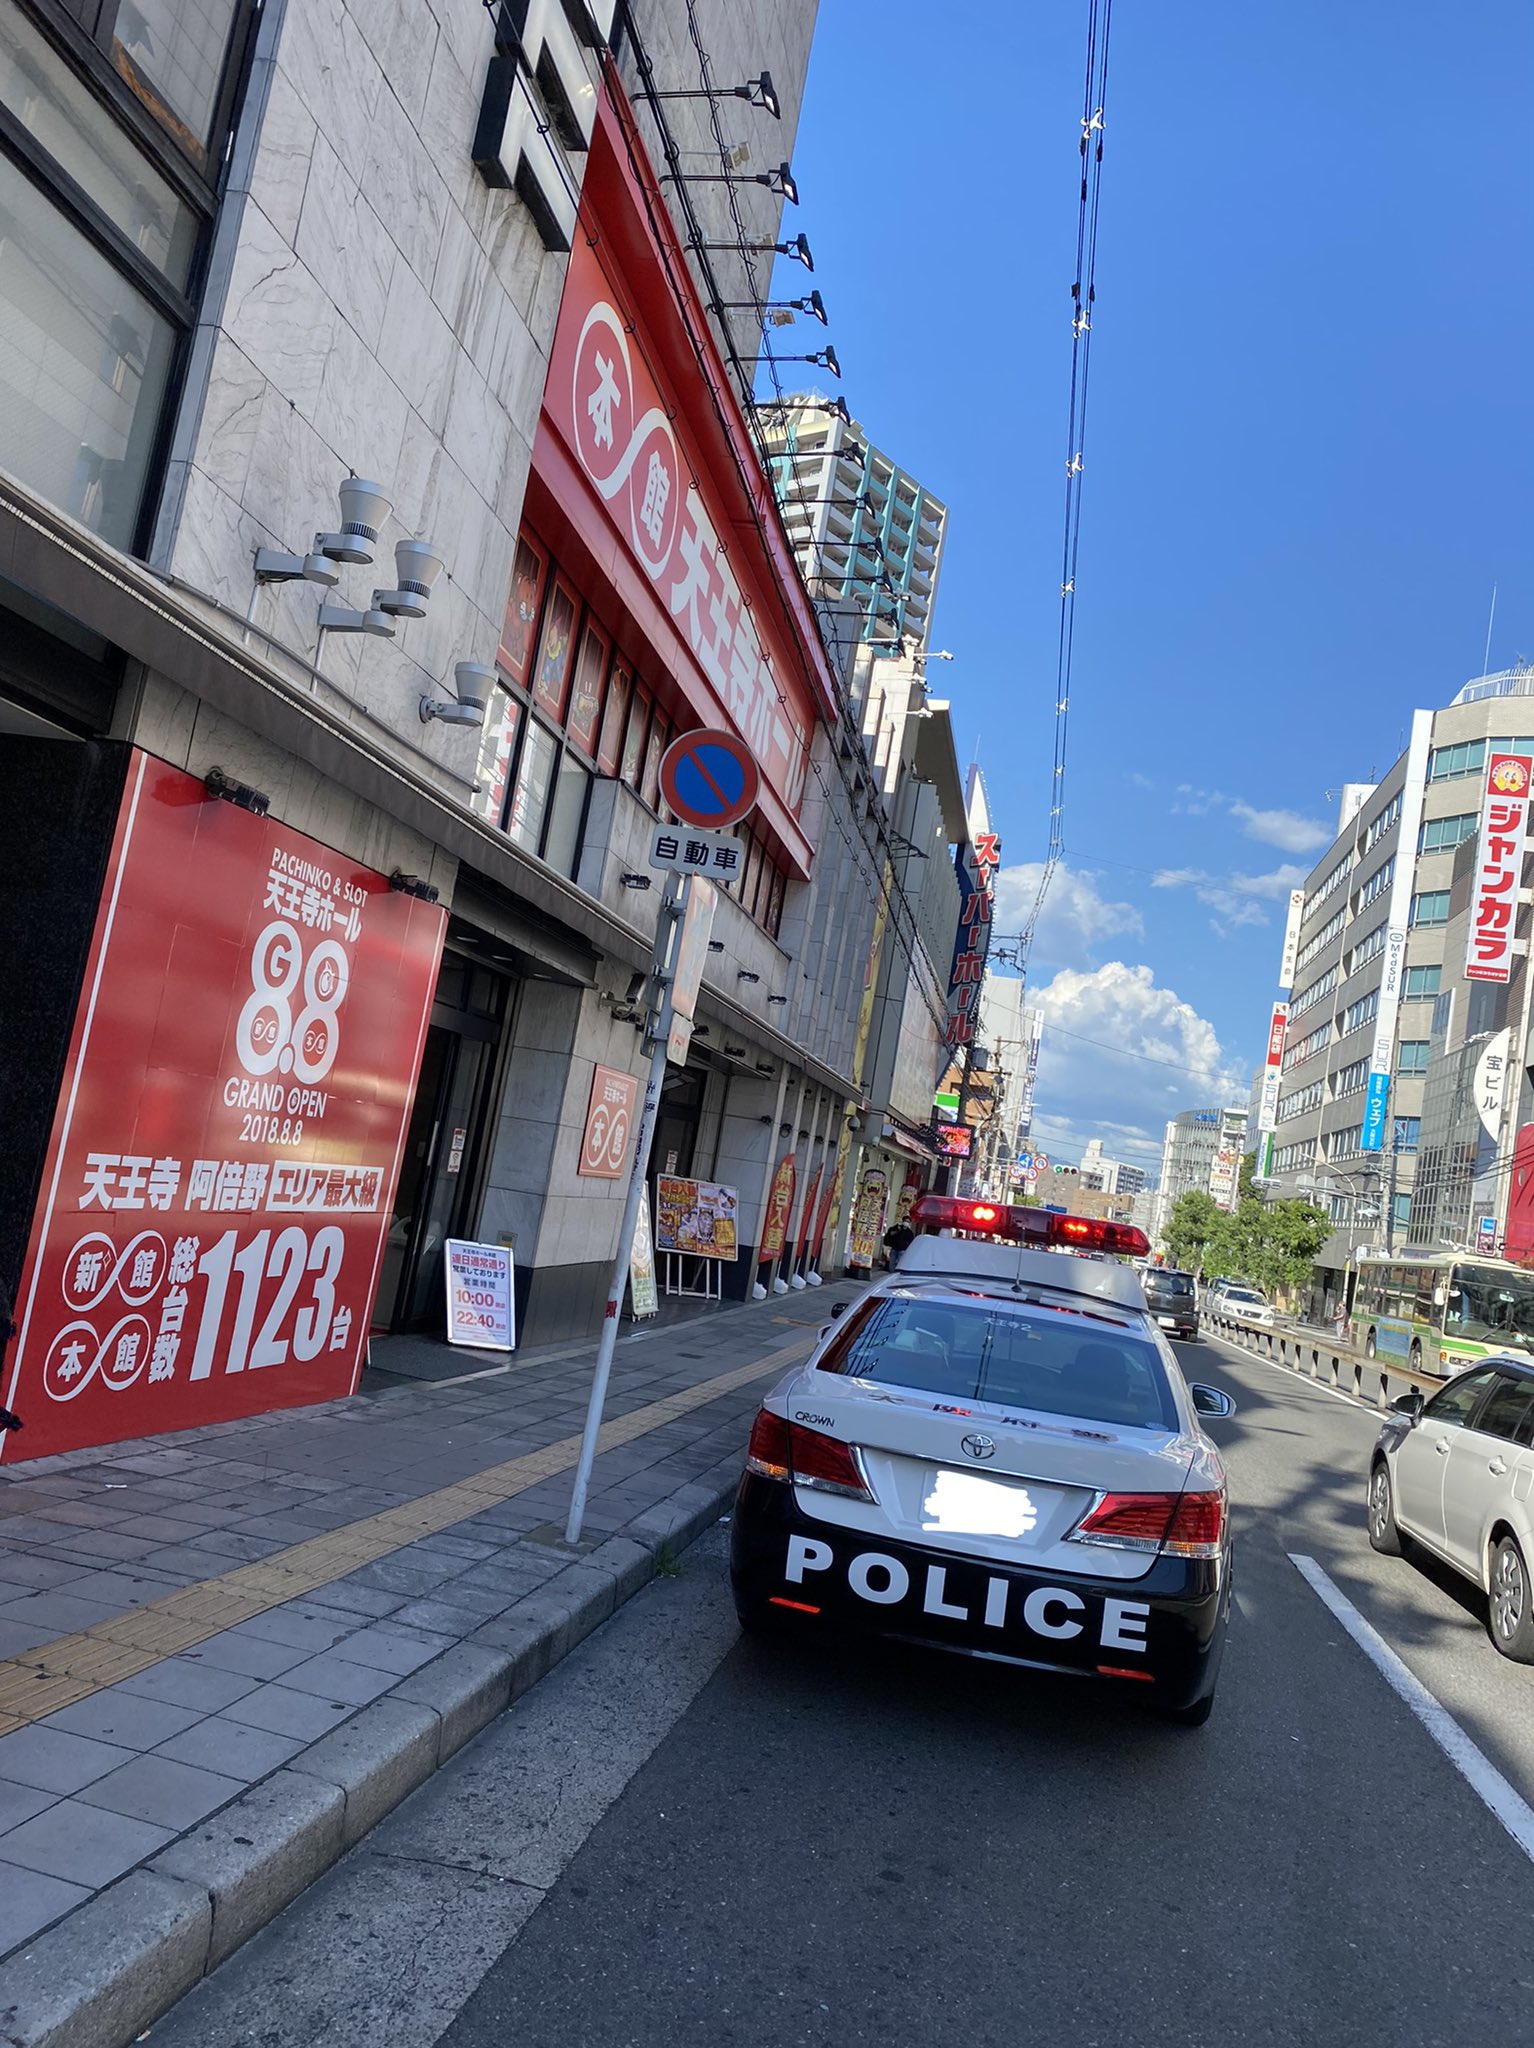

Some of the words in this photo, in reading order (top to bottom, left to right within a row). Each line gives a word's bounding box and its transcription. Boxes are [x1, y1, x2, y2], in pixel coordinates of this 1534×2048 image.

[671, 482, 807, 811] 天王寺ホール
[271, 847, 332, 891] PACHINKO
[332, 880, 342, 898] &
[343, 884, 369, 909] SLOT
[655, 836, 740, 871] 自動車
[263, 869, 363, 943] 天王寺ホール
[1474, 803, 1523, 961] ジャンカラ
[947, 832, 999, 1047] スーパーホール
[1386, 943, 1401, 992] MedSUR
[223, 1077, 284, 1113] GRAND
[286, 1086, 326, 1118] OPEN
[1483, 1054, 1503, 1110] 宝ビル
[239, 1113, 303, 1145] 2018.8.8
[78, 1152, 182, 1211] 天王寺
[184, 1159, 270, 1211] 阿倍野
[270, 1167, 381, 1209] エリア最大級
[73, 1249, 157, 1293] 新館
[456, 1289, 495, 1308] 10:00
[148, 1236, 200, 1384] 総台数
[190, 1226, 345, 1382] 1123
[456, 1310, 495, 1329] 22:40
[56, 1332, 140, 1383] 本館
[795, 1410, 835, 1428] CROWN
[784, 1533, 1152, 1653] POLICE
